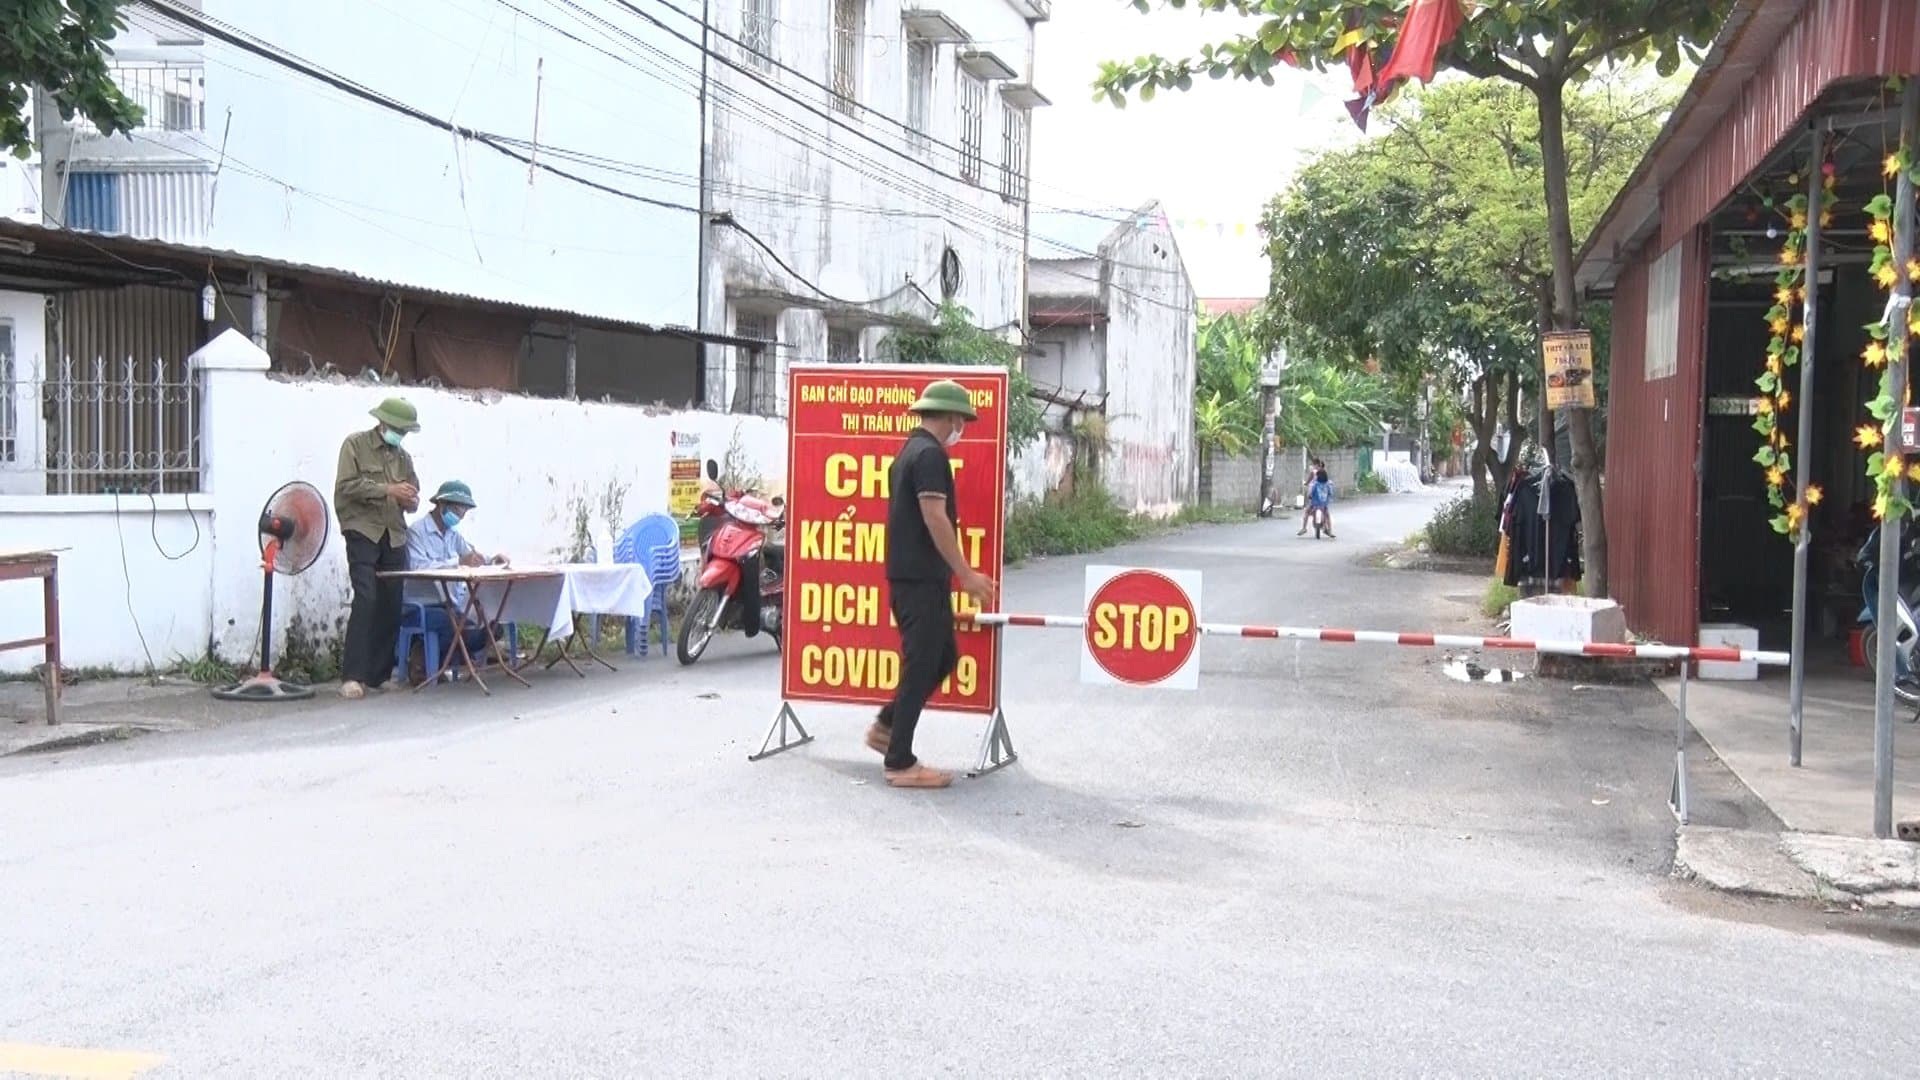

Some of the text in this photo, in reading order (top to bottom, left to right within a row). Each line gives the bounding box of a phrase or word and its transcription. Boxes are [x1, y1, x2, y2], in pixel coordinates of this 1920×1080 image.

[801, 385, 825, 403] BAN
[850, 386, 873, 407] ĐẠO
[876, 383, 917, 405] PHÒNG
[842, 412, 859, 434] THỊ
[863, 408, 893, 432] TRẤN
[800, 505, 885, 563] KIỂM
[800, 583, 879, 632] DỊCH
[1094, 602, 1189, 652] STOP
